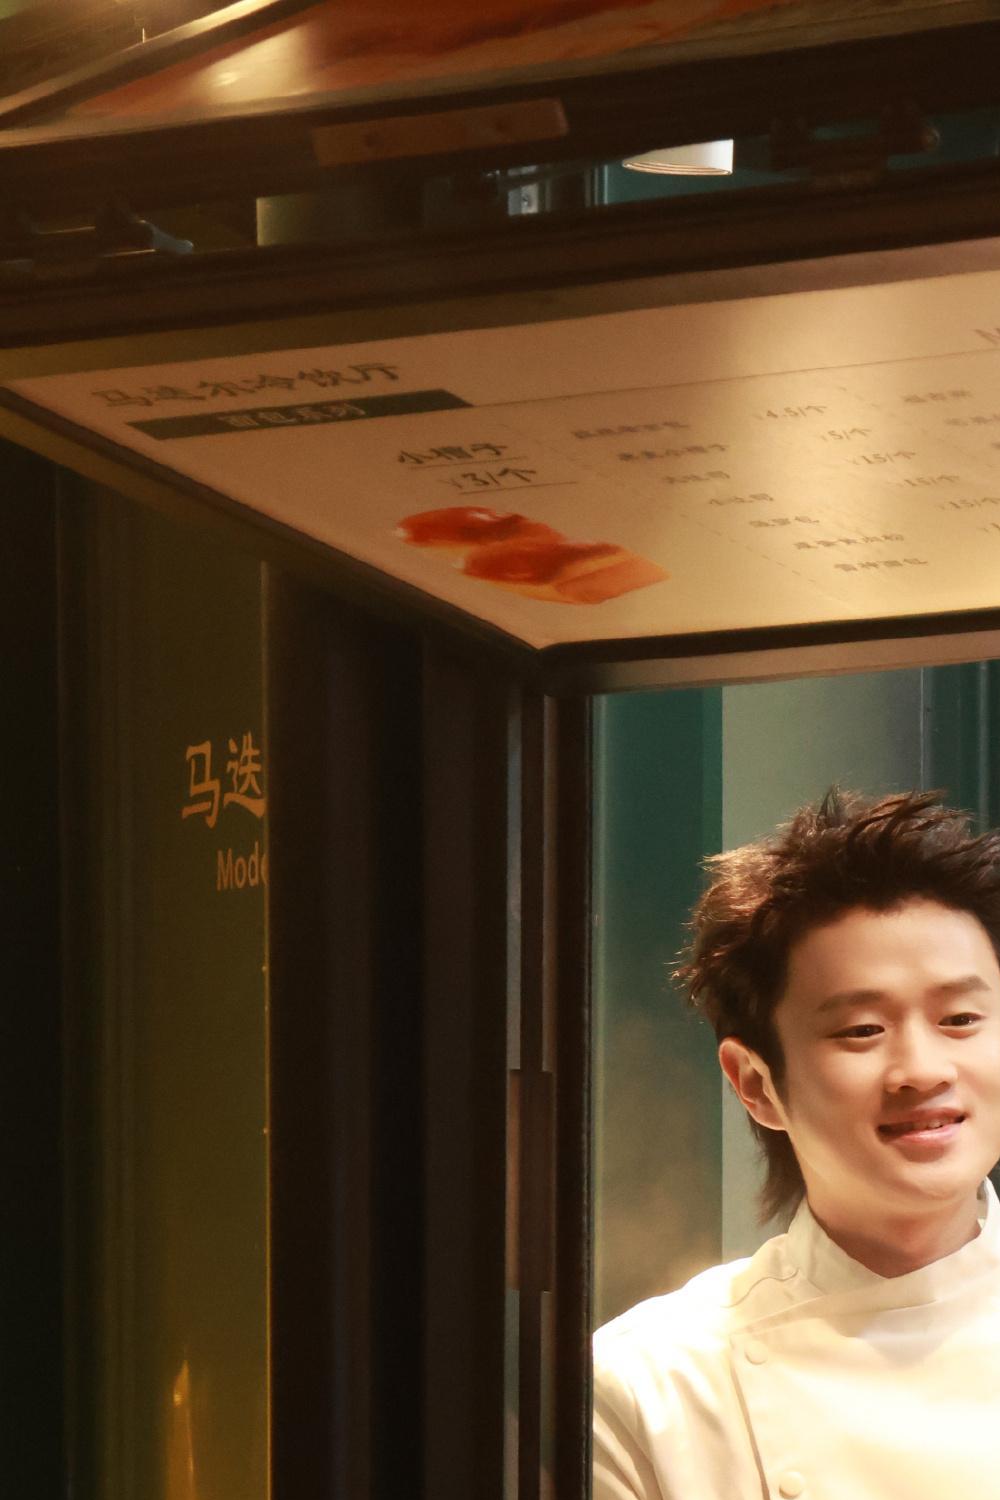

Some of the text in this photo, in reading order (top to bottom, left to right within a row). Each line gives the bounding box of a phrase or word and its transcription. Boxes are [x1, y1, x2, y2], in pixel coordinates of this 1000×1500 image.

[92, 362, 399, 406] 马迭尔冷饮厅
[217, 403, 367, 428] 面包系列
[182, 731, 266, 829] 马迭
